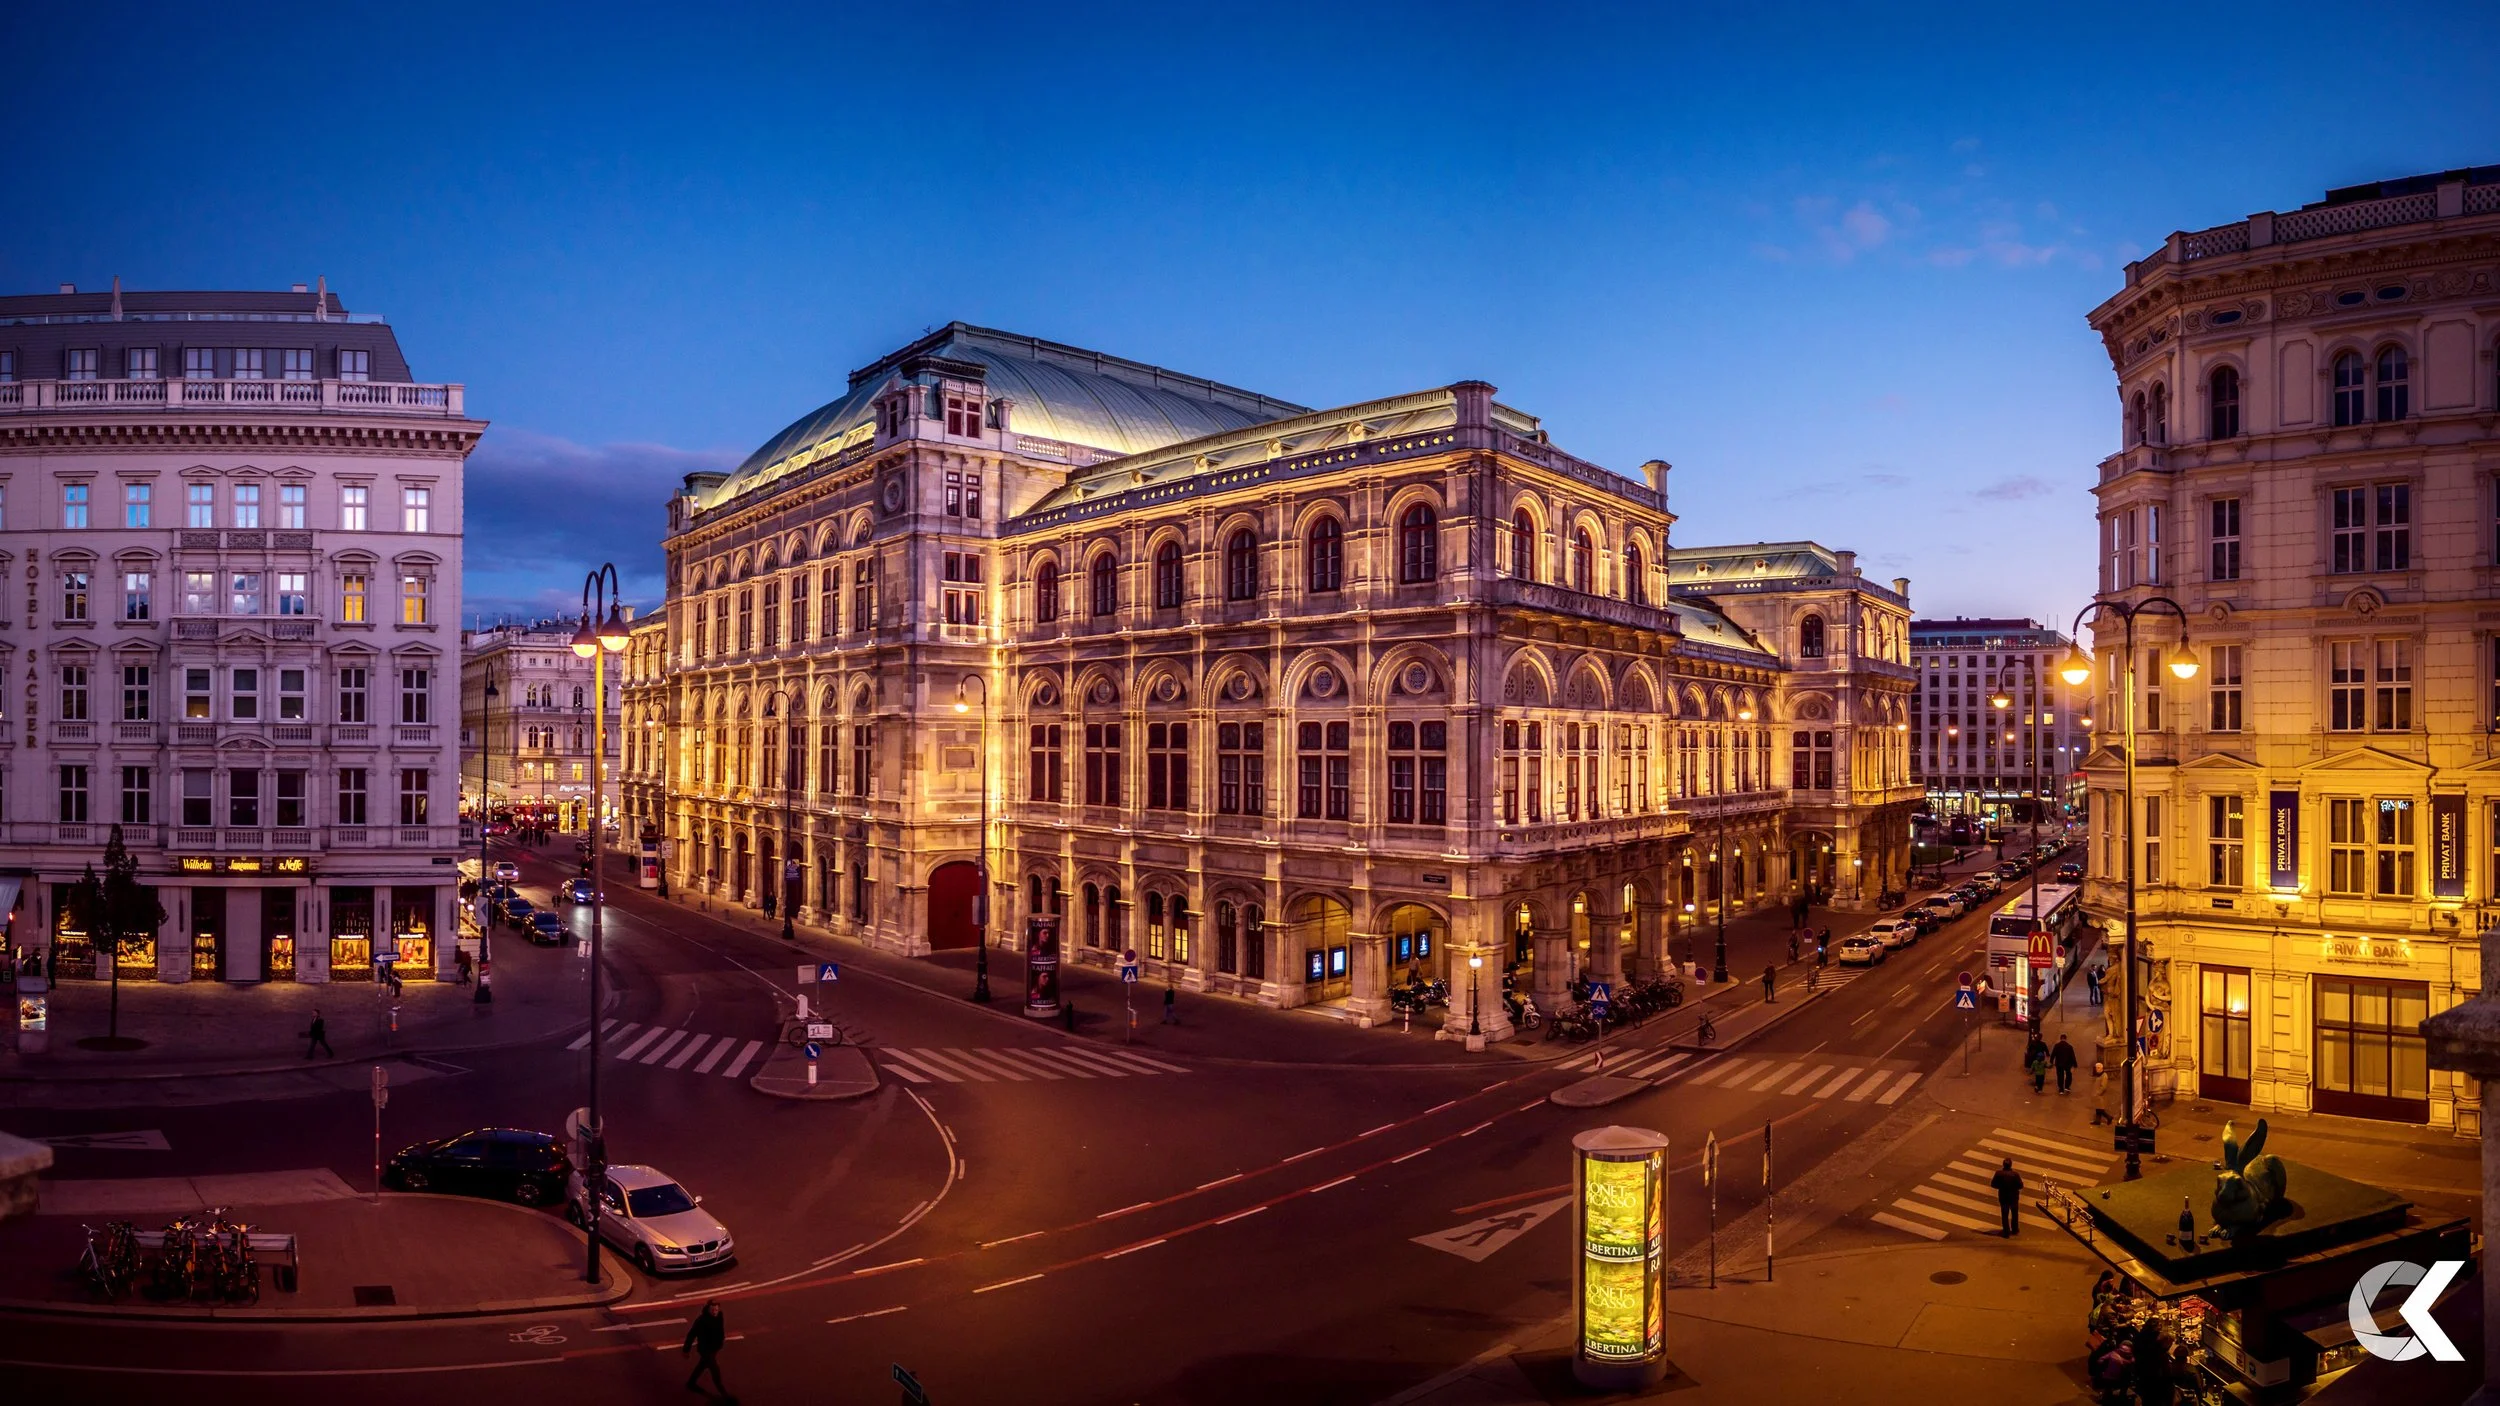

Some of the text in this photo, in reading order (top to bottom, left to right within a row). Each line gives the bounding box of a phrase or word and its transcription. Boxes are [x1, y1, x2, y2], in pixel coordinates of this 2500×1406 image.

[26, 548, 39, 748] HOTEL SACHER
[183, 858, 213, 870] Wilhelm
[2277, 808, 2286, 871] PRIVAT BANK
[2441, 812, 2450, 879] PRIVAT BANK
[2326, 943, 2409, 959] PRIVAT BANK
